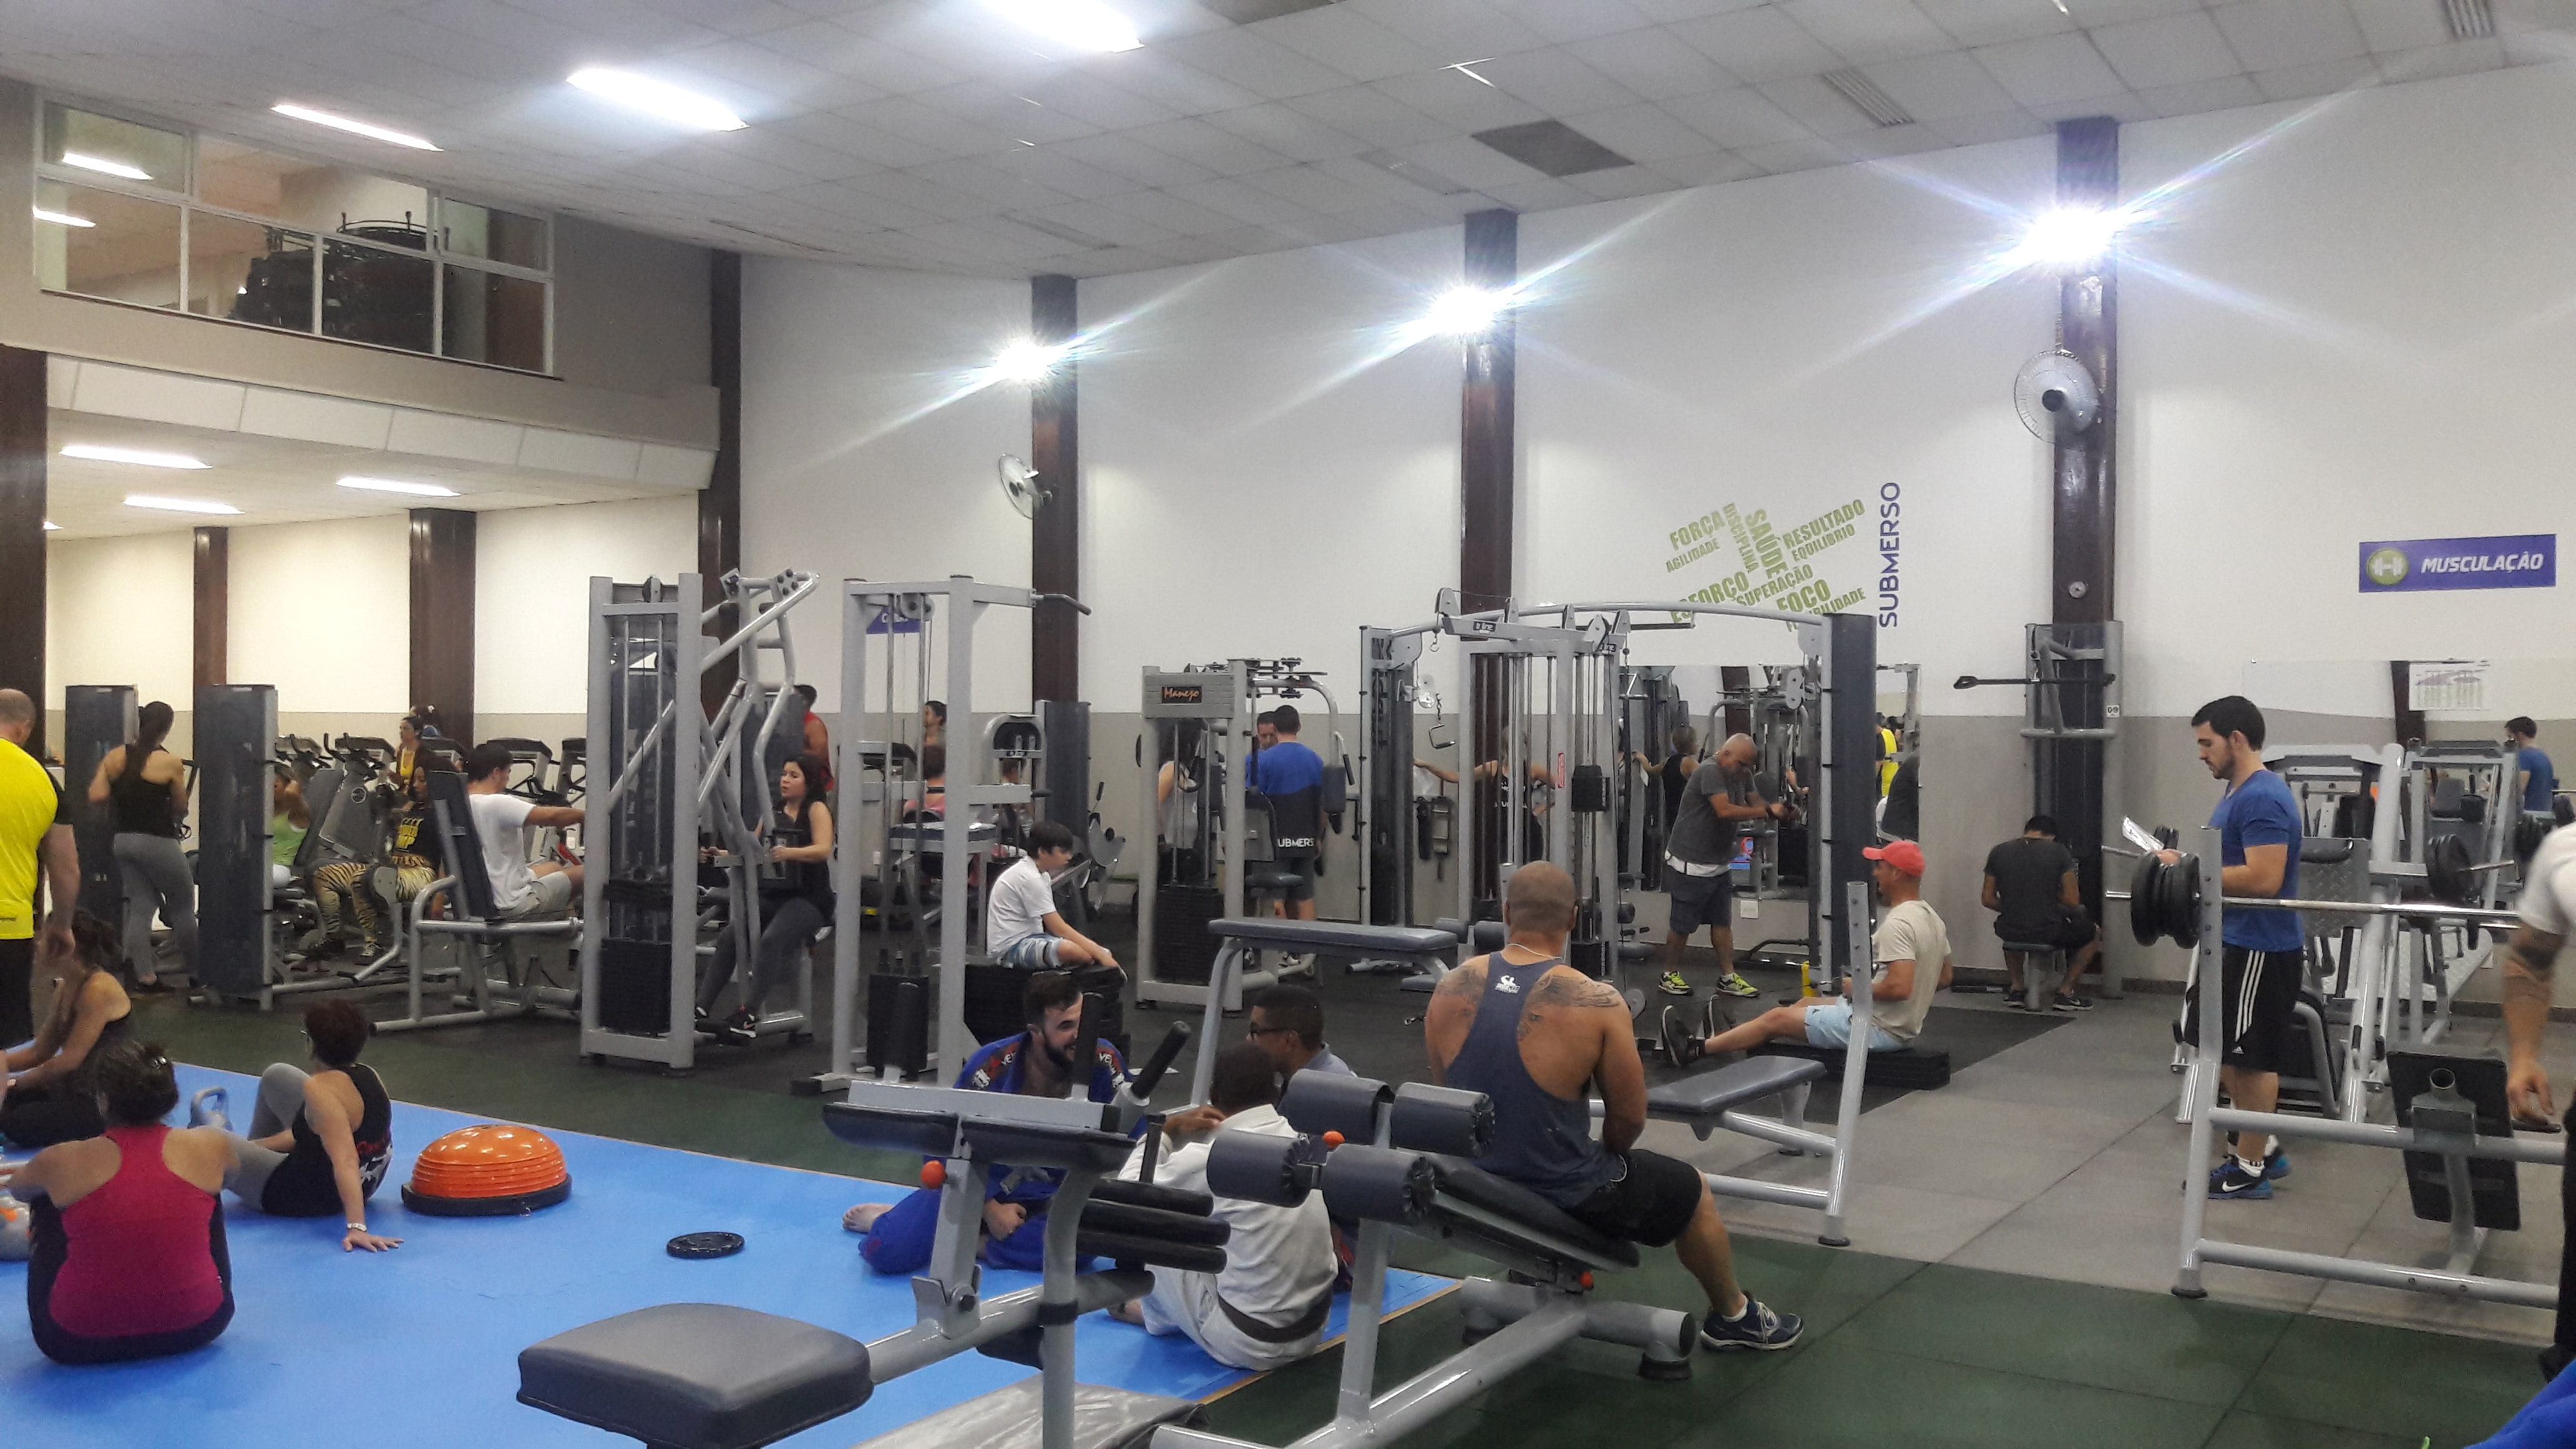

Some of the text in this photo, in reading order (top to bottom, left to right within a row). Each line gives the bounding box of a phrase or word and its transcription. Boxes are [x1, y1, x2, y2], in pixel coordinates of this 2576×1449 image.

[1669, 510, 1724, 551] FORÇA
[1745, 509, 1788, 579] SAÚDE
[1782, 499, 1866, 549] RESULTADO
[1666, 538, 1720, 573] AGILIDADE
[1879, 482, 1901, 628] SUBMERSO
[2421, 551, 2544, 573] MUSCULAÇÃO
[1736, 564, 1813, 607] SUPERAÇÃO
[1776, 579, 1831, 612] FOCO
[1278, 838, 1314, 847] UBMERS
